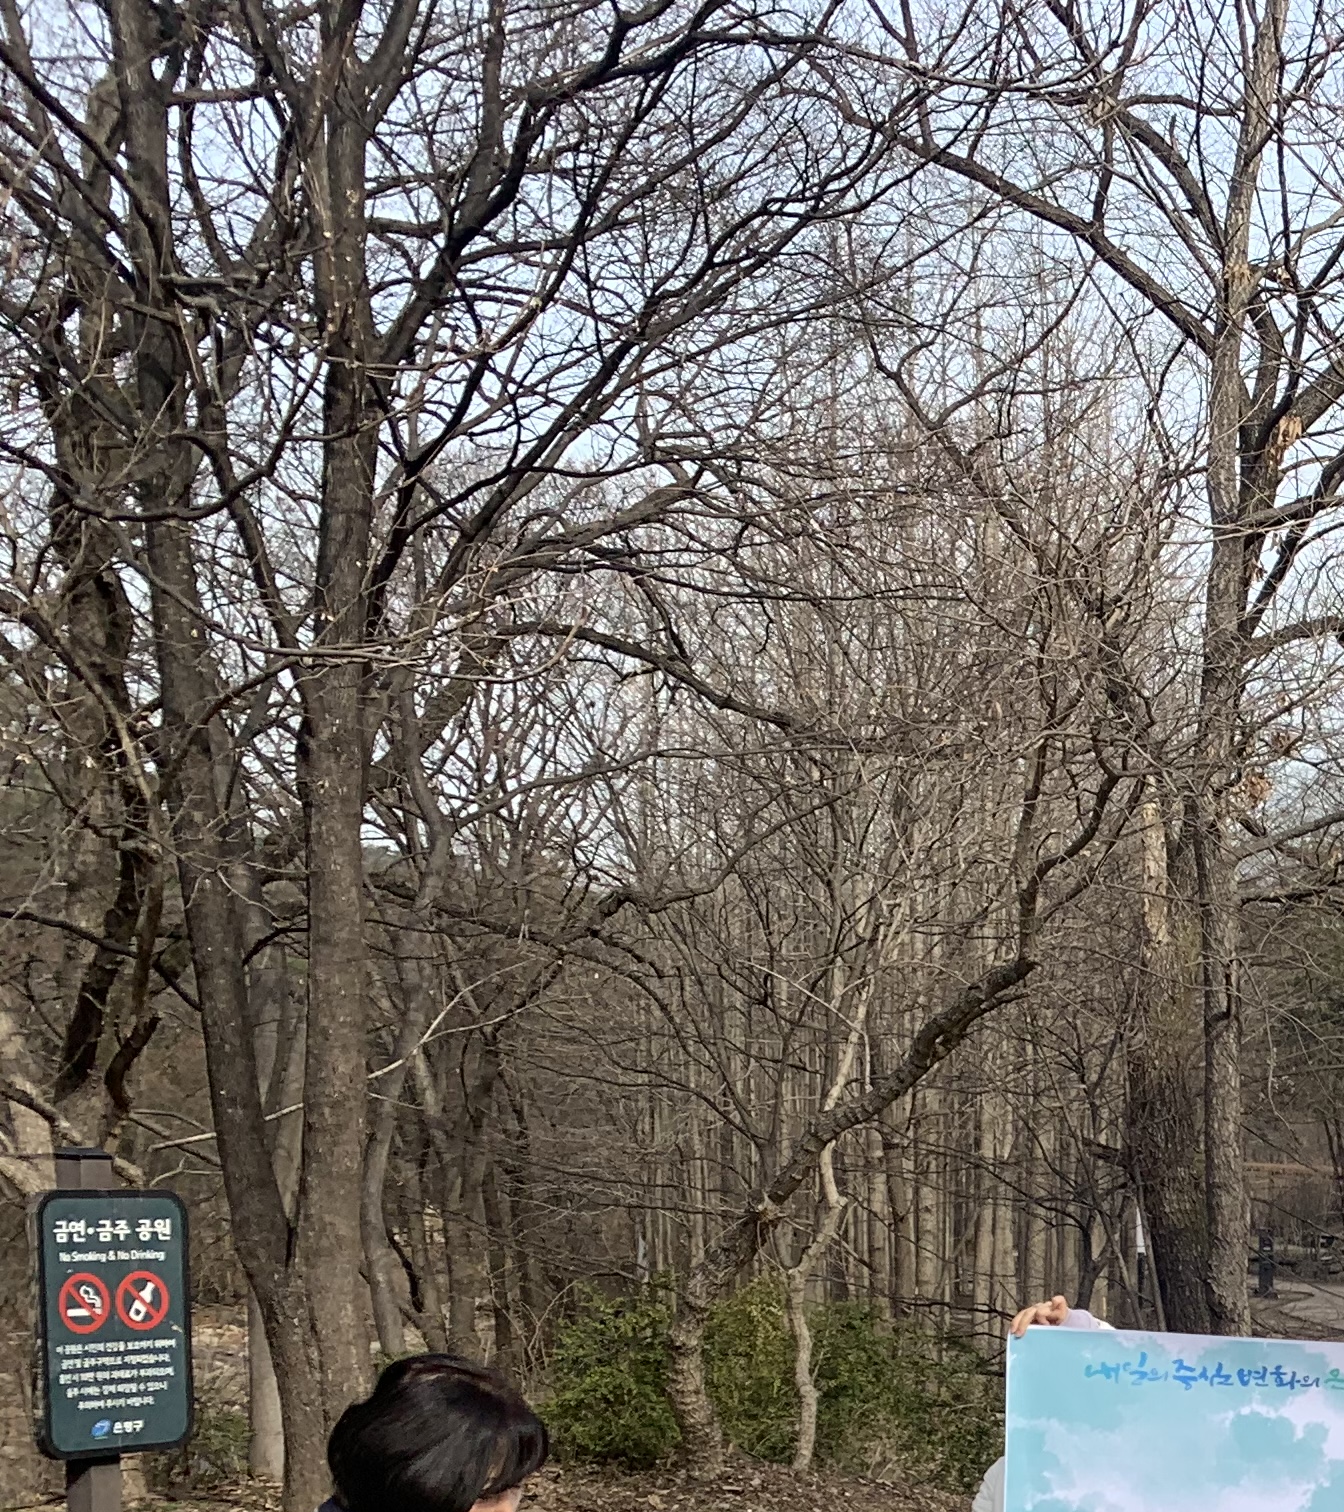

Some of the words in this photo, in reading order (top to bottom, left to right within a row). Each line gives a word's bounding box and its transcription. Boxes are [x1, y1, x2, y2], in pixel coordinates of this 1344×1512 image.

[135, 1218, 172, 1241] 공원
[58, 1252, 71, 1262] No
[71, 1251, 107, 1263] Smoking
[107, 1251, 116, 1261] &
[117, 1250, 130, 1260] No
[130, 1250, 165, 1262] Drinking
[1236, 1365, 1321, 1391] 변화의
[113, 1420, 145, 1434] 은평구
